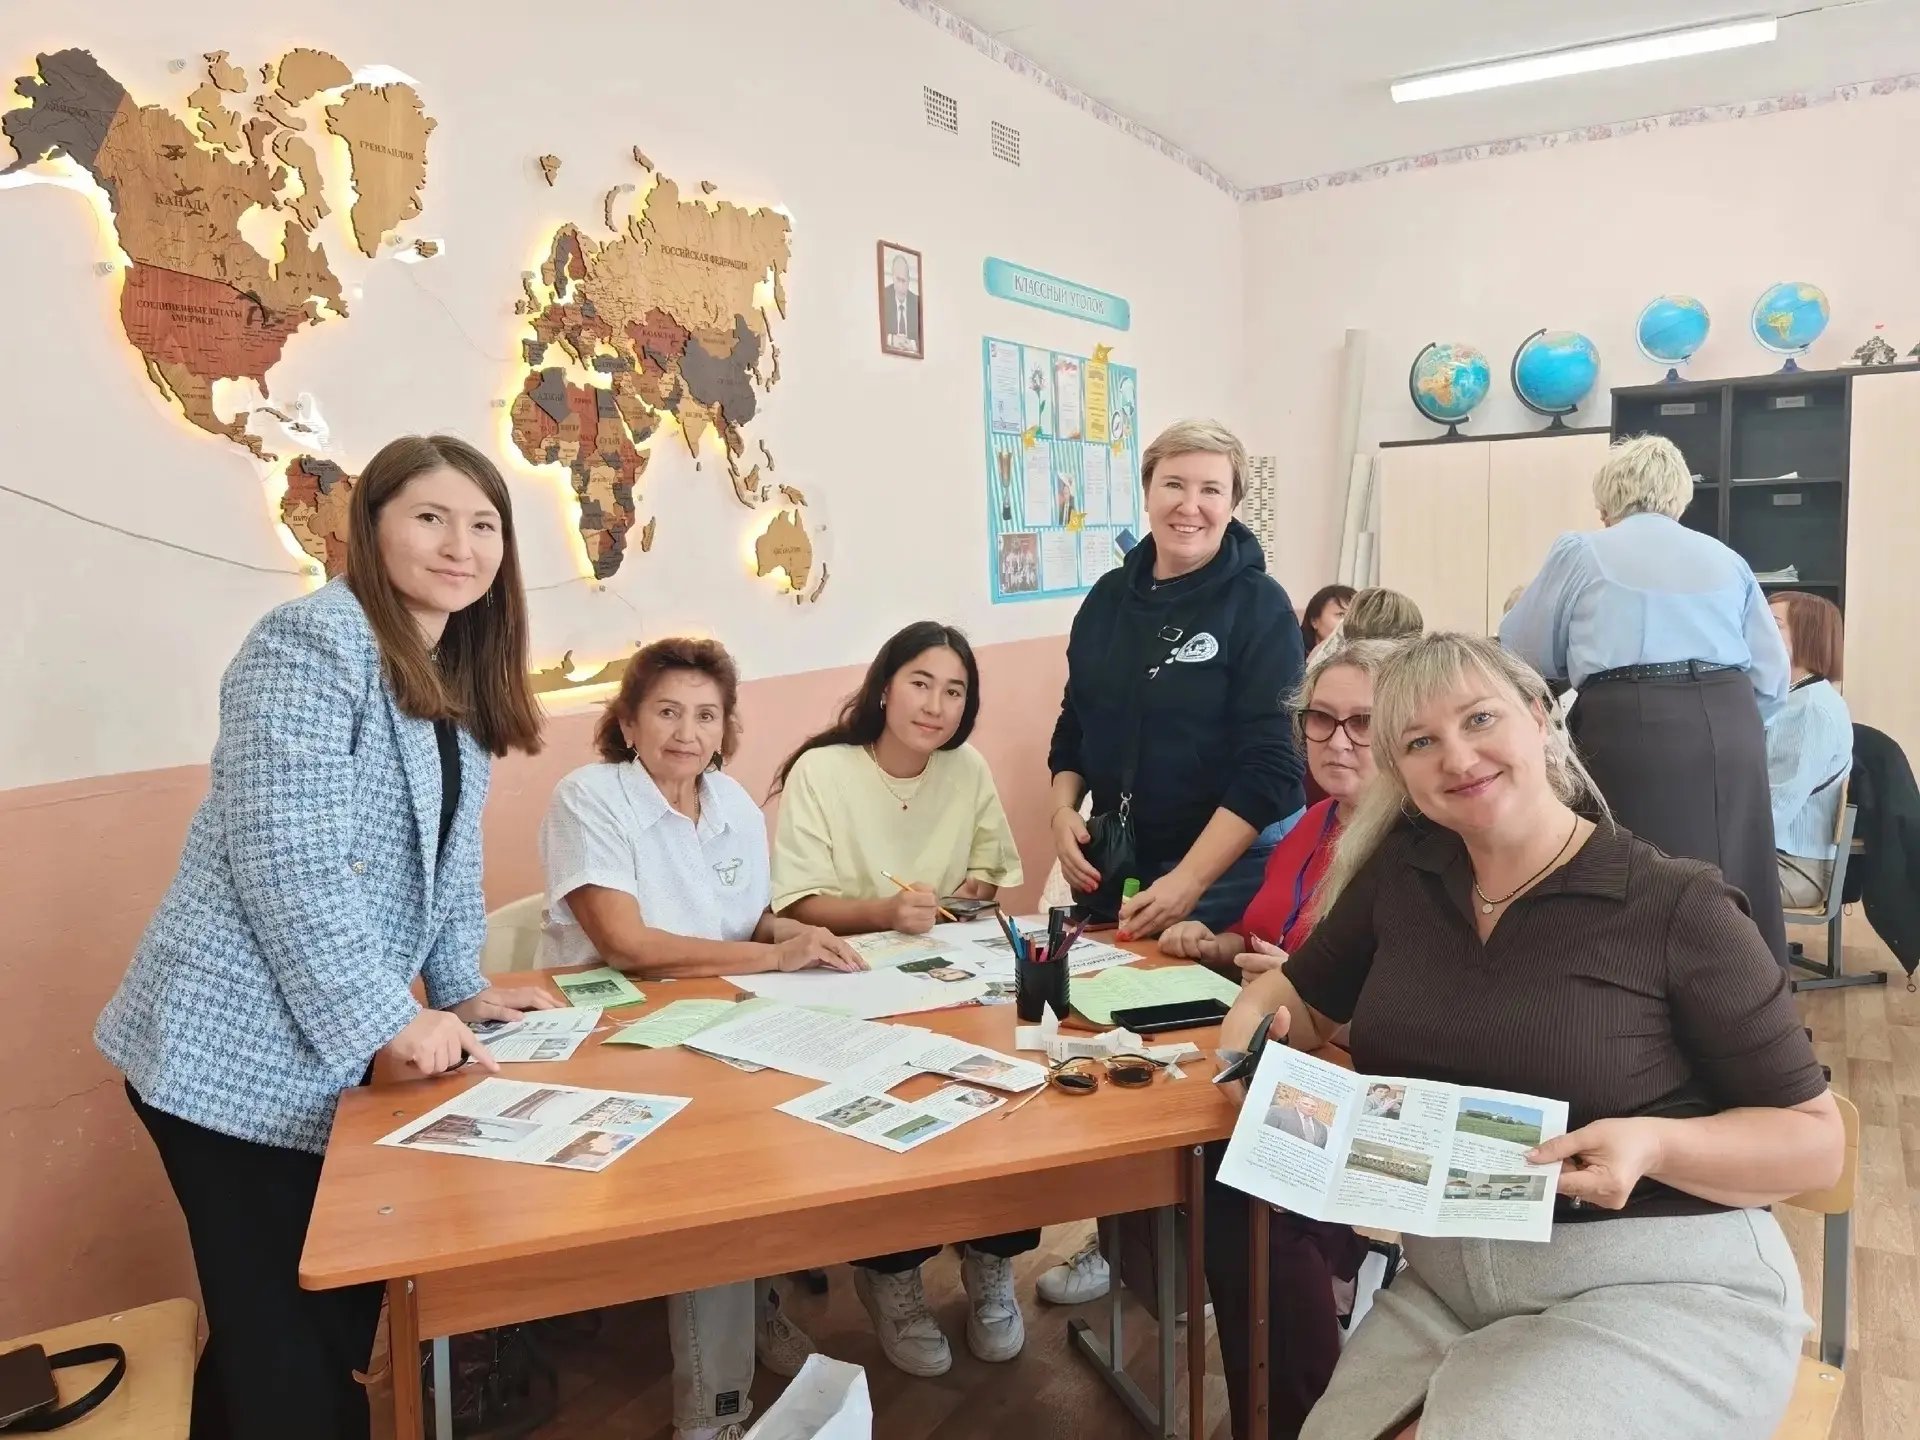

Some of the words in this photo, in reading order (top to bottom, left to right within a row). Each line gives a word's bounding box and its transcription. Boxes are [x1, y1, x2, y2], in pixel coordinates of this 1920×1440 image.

[360, 140, 414, 160] ГРЕНЛАНДИЯ
[154, 192, 210, 212] КАНАДА
[661, 244, 709, 262] РОССИЙСКАЯ
[709, 255, 748, 270] ФЕДЕРАЦИЯ
[1014, 274, 1067, 304] КЛАССНЫЙ
[1070, 291, 1105, 315] УГОЛОК
[210, 307, 243, 319] ШТАТЫ
